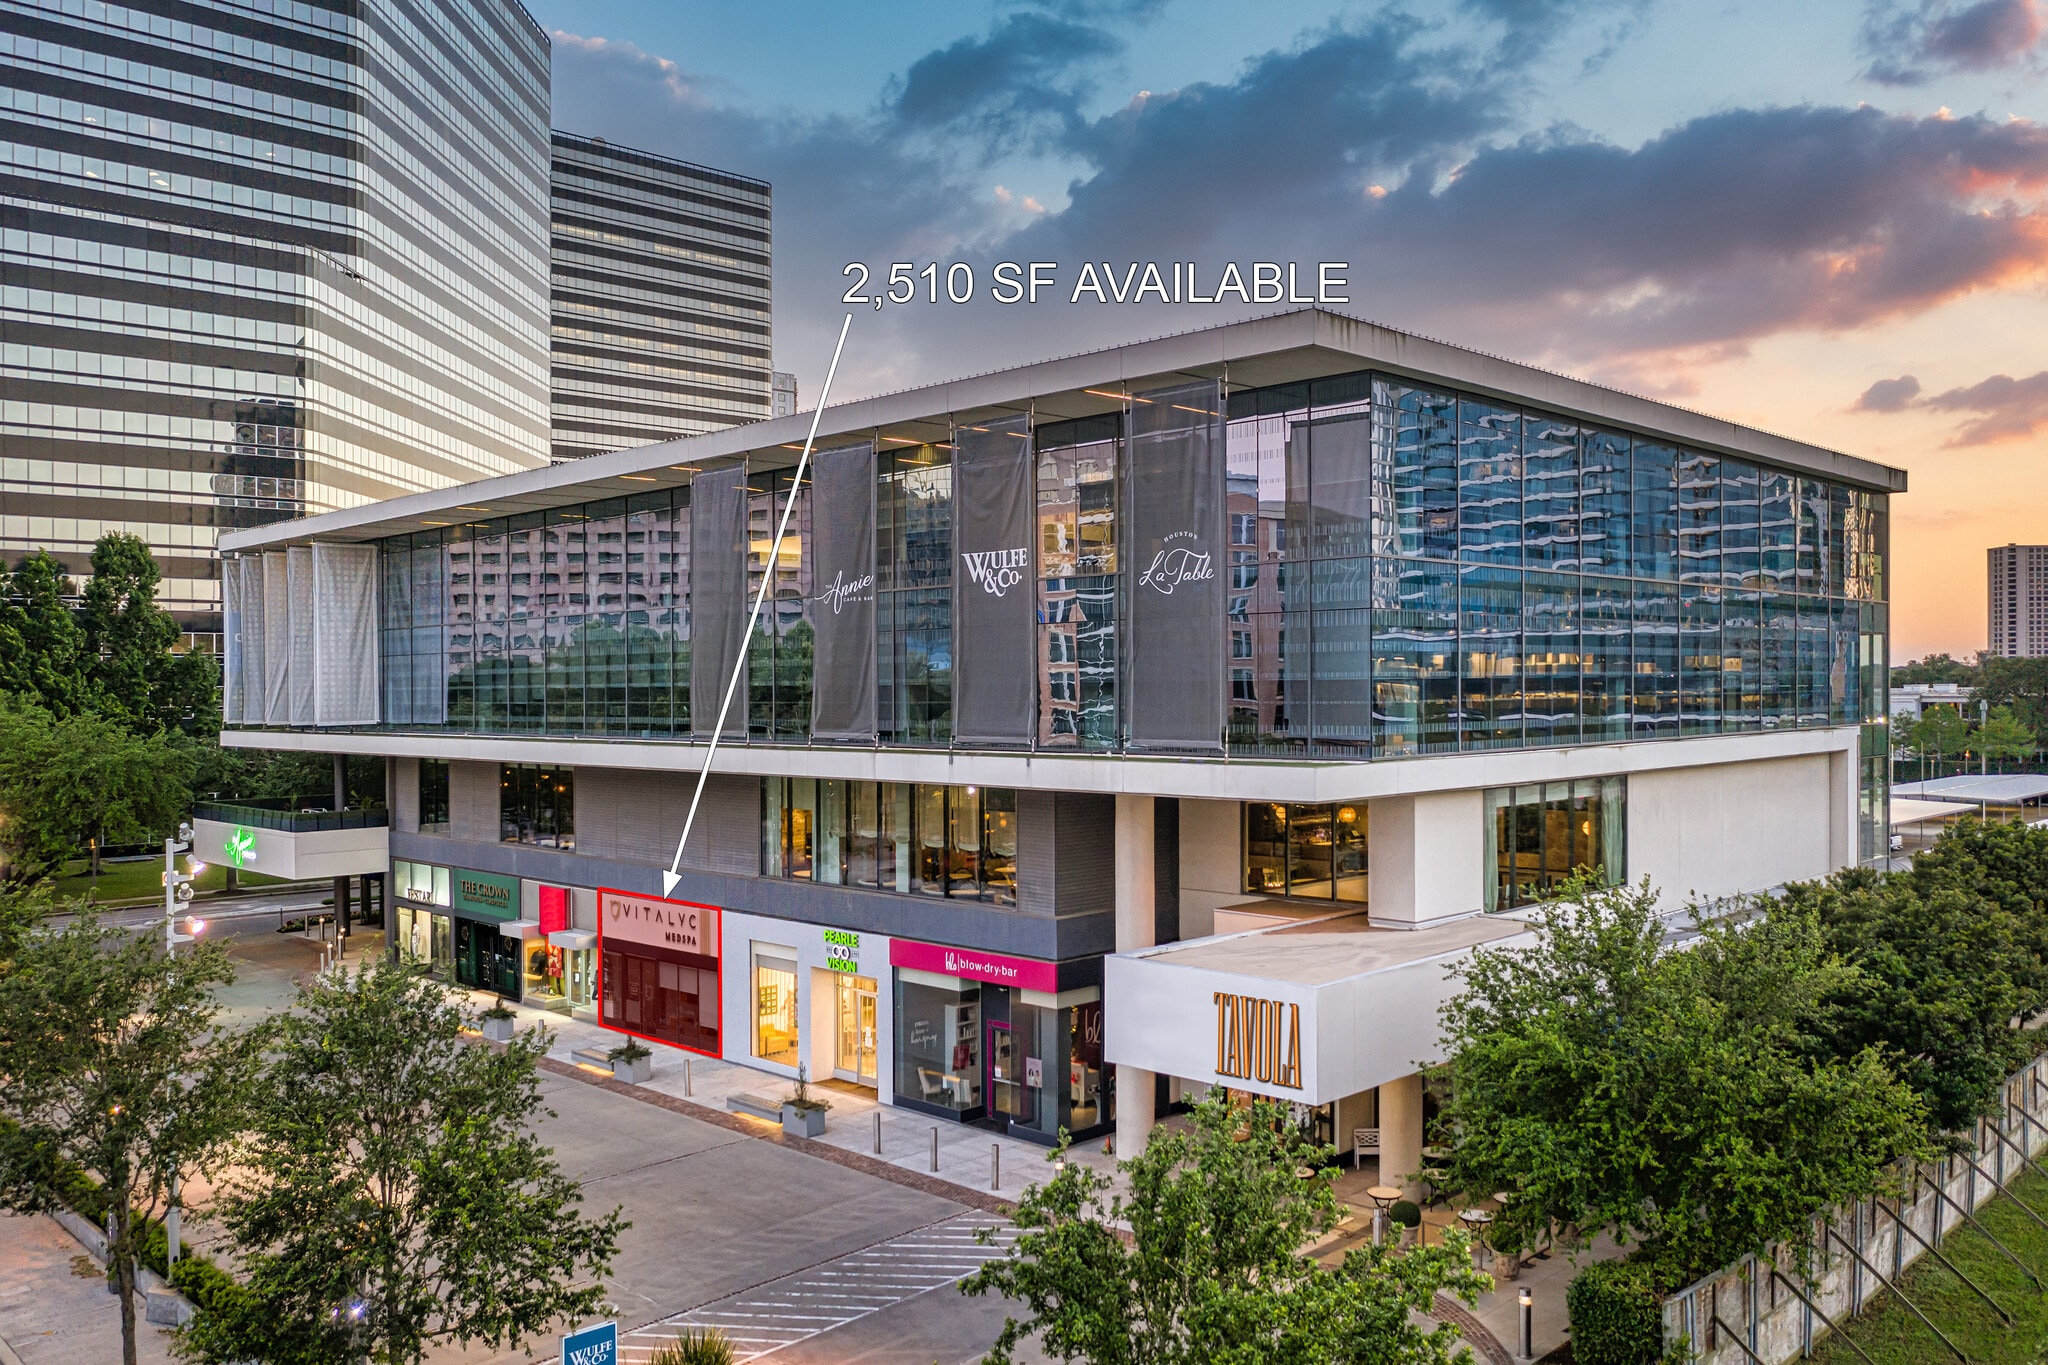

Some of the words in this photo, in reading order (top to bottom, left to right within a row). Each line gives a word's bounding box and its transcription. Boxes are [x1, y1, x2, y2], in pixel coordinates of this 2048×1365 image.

[1163, 531, 1198, 543] HOUSTON
[961, 548, 1028, 583] WULFE
[1139, 550, 1173, 595] La
[1164, 548, 1214, 585] Table
[814, 570, 874, 614] Annie
[460, 880, 476, 894] THE
[478, 880, 510, 900] CROWN
[623, 904, 697, 929] VITALYC
[665, 932, 697, 947] MEDSPA
[823, 929, 859, 948] PEARLE
[826, 957, 857, 973] VISION
[1213, 991, 1303, 1090] TAVOLA
[568, 1340, 613, 1365] WULFE
